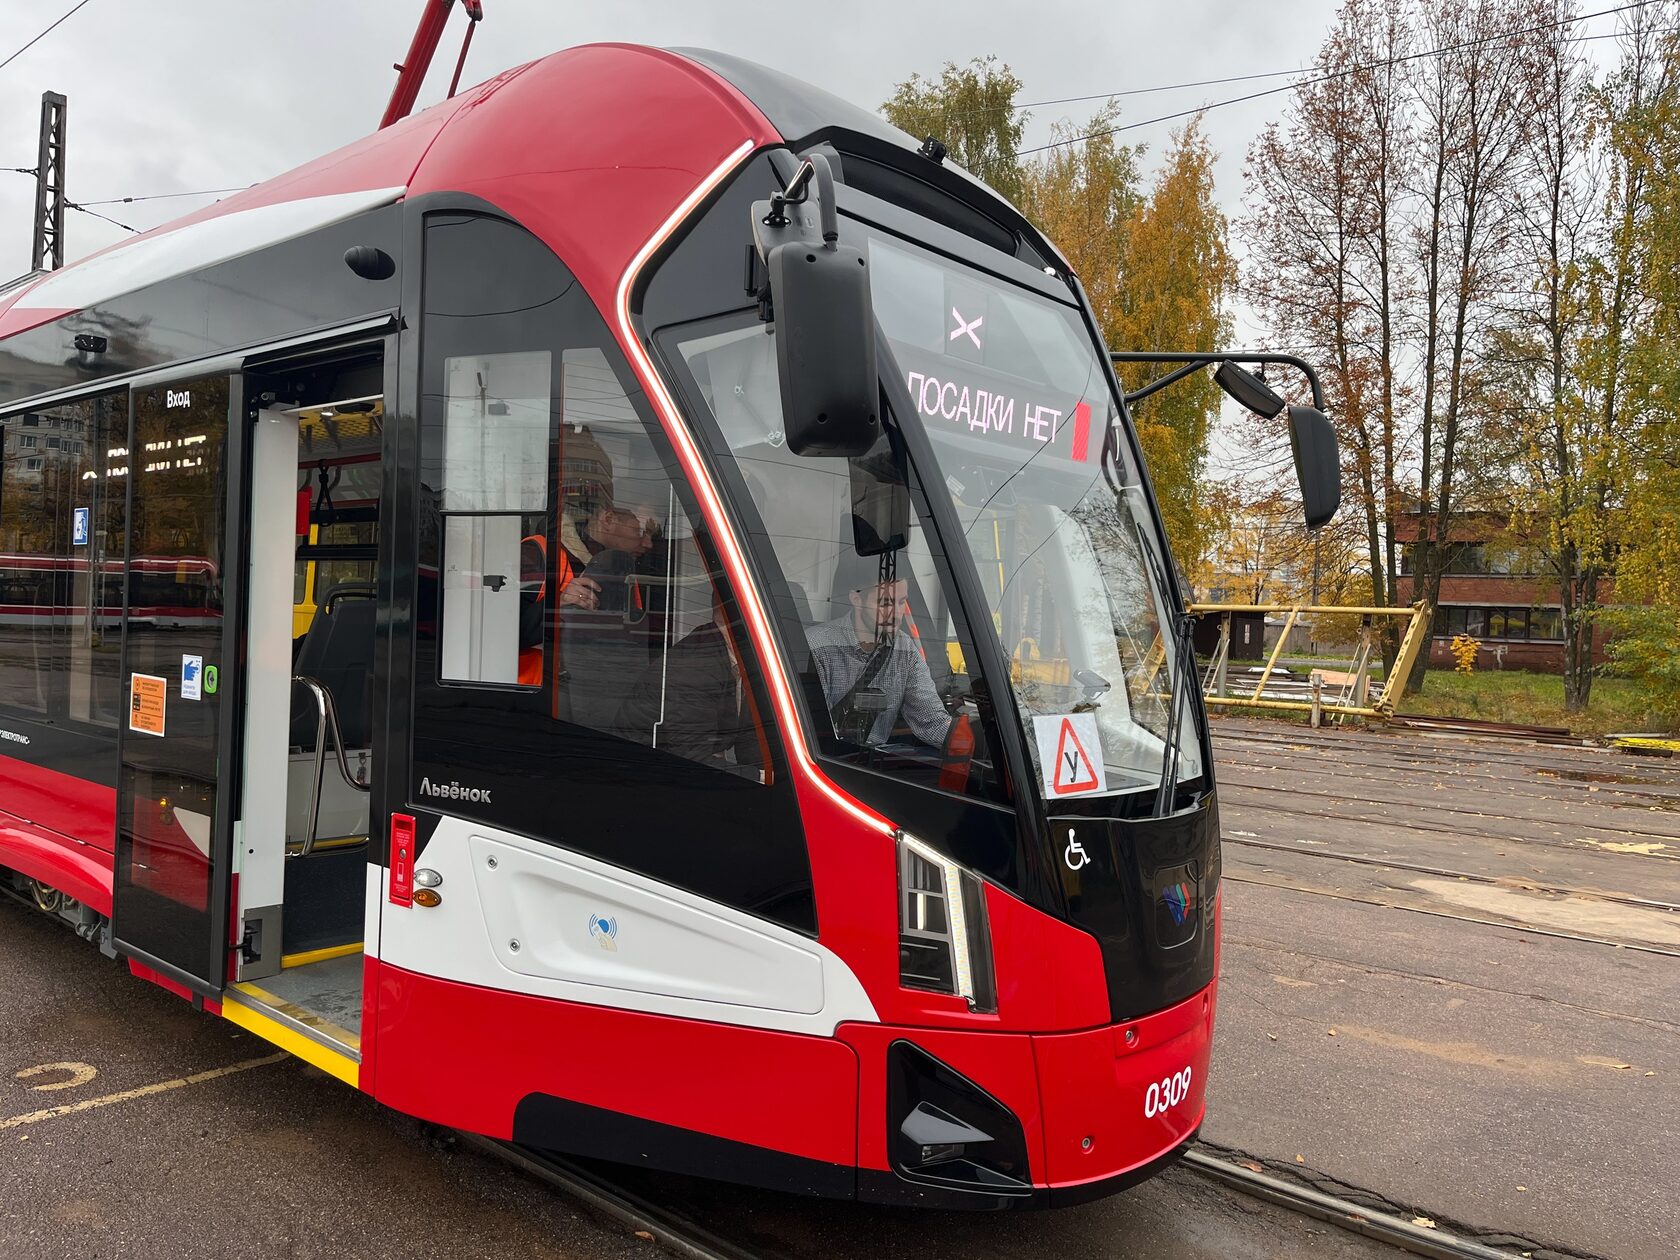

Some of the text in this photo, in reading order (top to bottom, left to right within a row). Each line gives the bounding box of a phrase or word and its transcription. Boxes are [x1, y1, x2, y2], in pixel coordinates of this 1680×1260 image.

[166, 390, 191, 408] Вход
[908, 371, 1062, 443] ПОСАДКИ НЕТ
[419, 777, 492, 803] Львёнок
[1144, 1066, 1192, 1118] 0309
